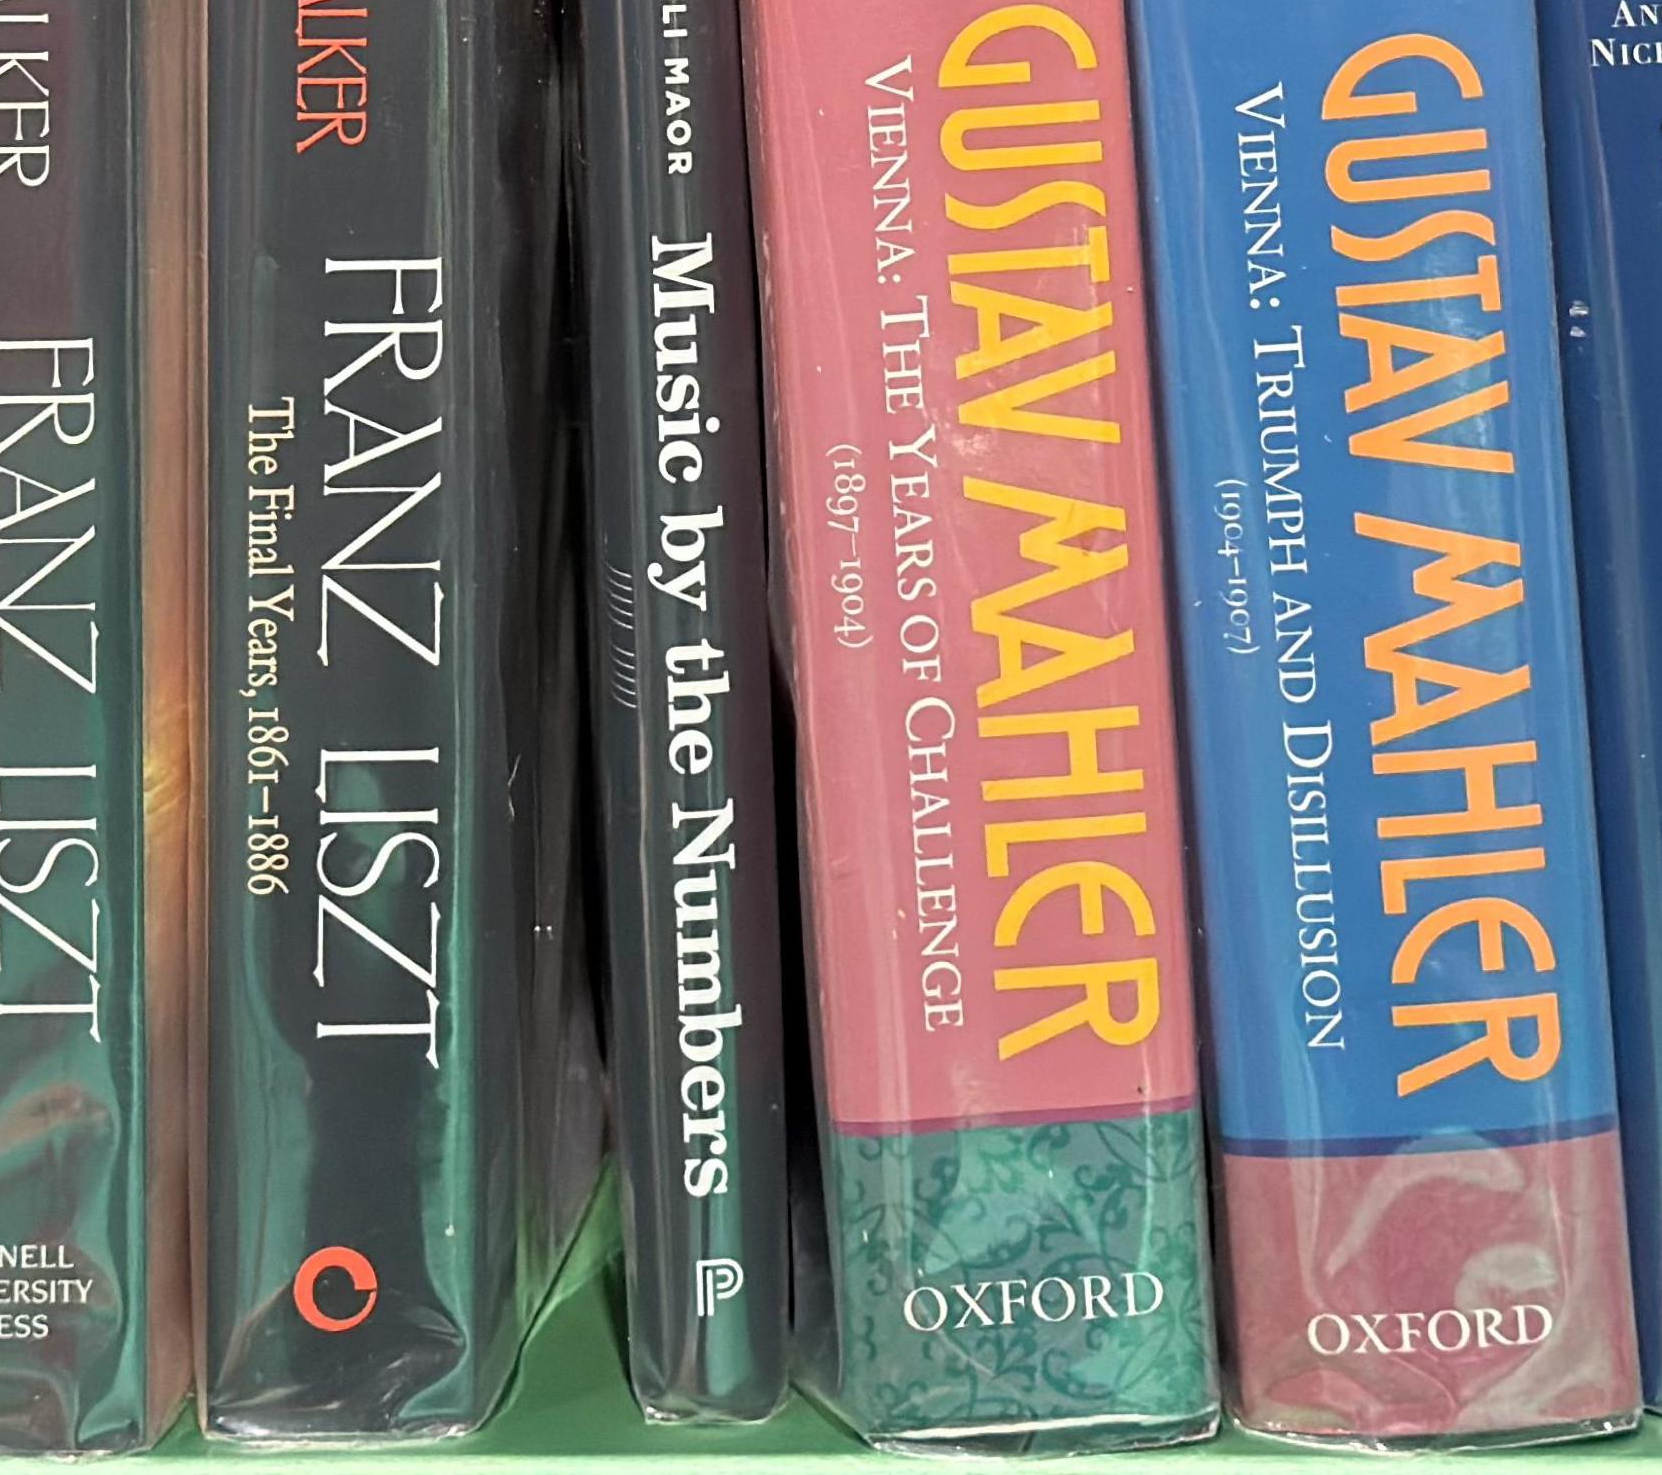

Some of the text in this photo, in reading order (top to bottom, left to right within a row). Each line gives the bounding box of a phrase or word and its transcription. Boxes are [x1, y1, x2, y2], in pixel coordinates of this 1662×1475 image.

[663, 56, 693, 175] MAOR
[864, 54, 918, 286] VIENNA:
[651, 231, 722, 485] Music
[879, 296, 929, 415] THE
[238, 396, 295, 697] The Final Years,
[646, 504, 725, 611] by
[888, 423, 939, 601] YEARS
[937, 3, 1162, 1062] GUSTAV MAHLER
[1234, 80, 1346, 1050] VIENNA: TRIUMPH AND DISILLUSION
[1321, 32, 1563, 1097] GUSTAV MAHLER
[311, 256, 446, 1070] FRANZ LISZT
[665, 643, 731, 776] the
[904, 696, 965, 1033] CHALLENGE
[670, 797, 743, 1198] Numbers
[903, 1270, 1165, 1332] OXFORD
[1306, 1303, 1554, 1357] OXFORD
